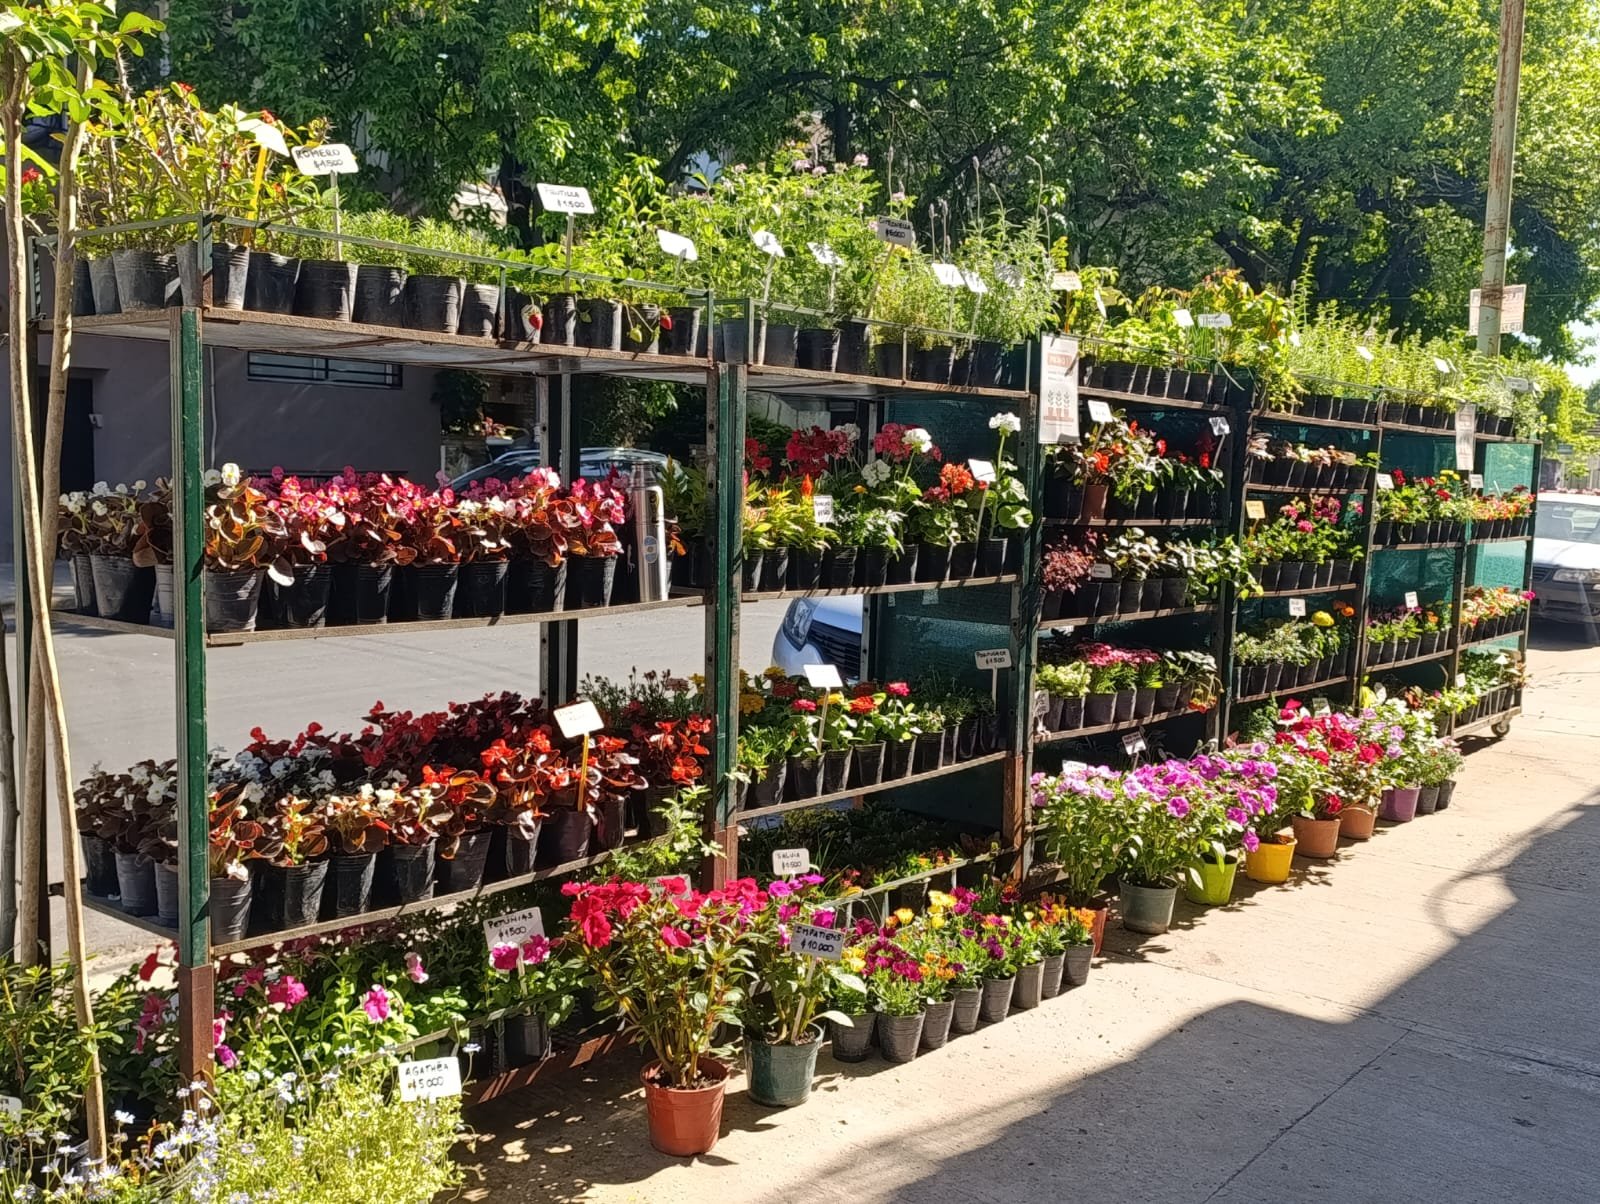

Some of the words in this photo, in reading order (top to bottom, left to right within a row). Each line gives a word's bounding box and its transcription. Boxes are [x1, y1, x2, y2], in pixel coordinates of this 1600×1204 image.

[294, 149, 341, 159] ROMERO
[487, 911, 533, 929] PETUNIAS
[795, 925, 842, 942] IMPATIENS
